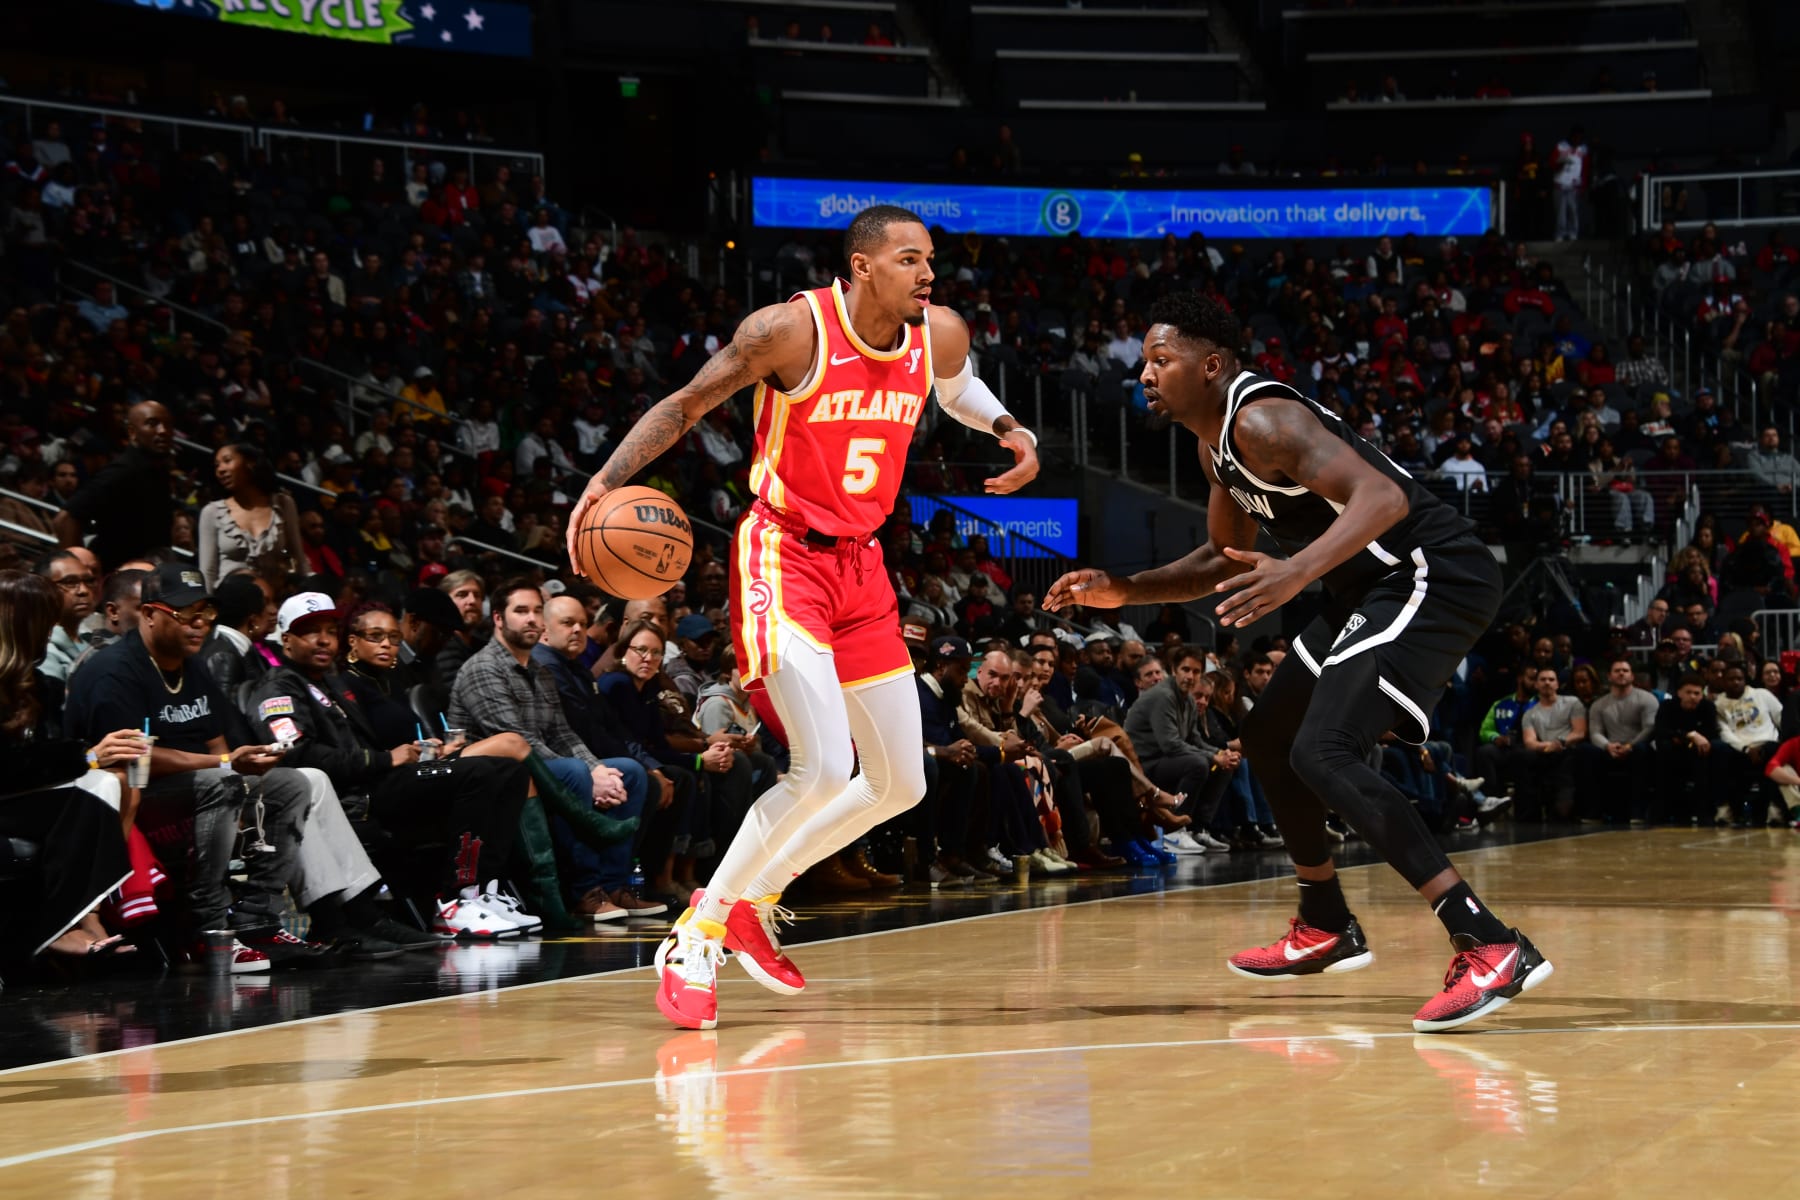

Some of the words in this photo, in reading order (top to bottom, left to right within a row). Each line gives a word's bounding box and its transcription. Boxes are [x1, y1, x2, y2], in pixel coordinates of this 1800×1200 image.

[1170, 203, 1279, 223] Innovation
[1286, 203, 1326, 223] that
[1333, 203, 1426, 222] delivers.
[842, 437, 886, 495] 5
